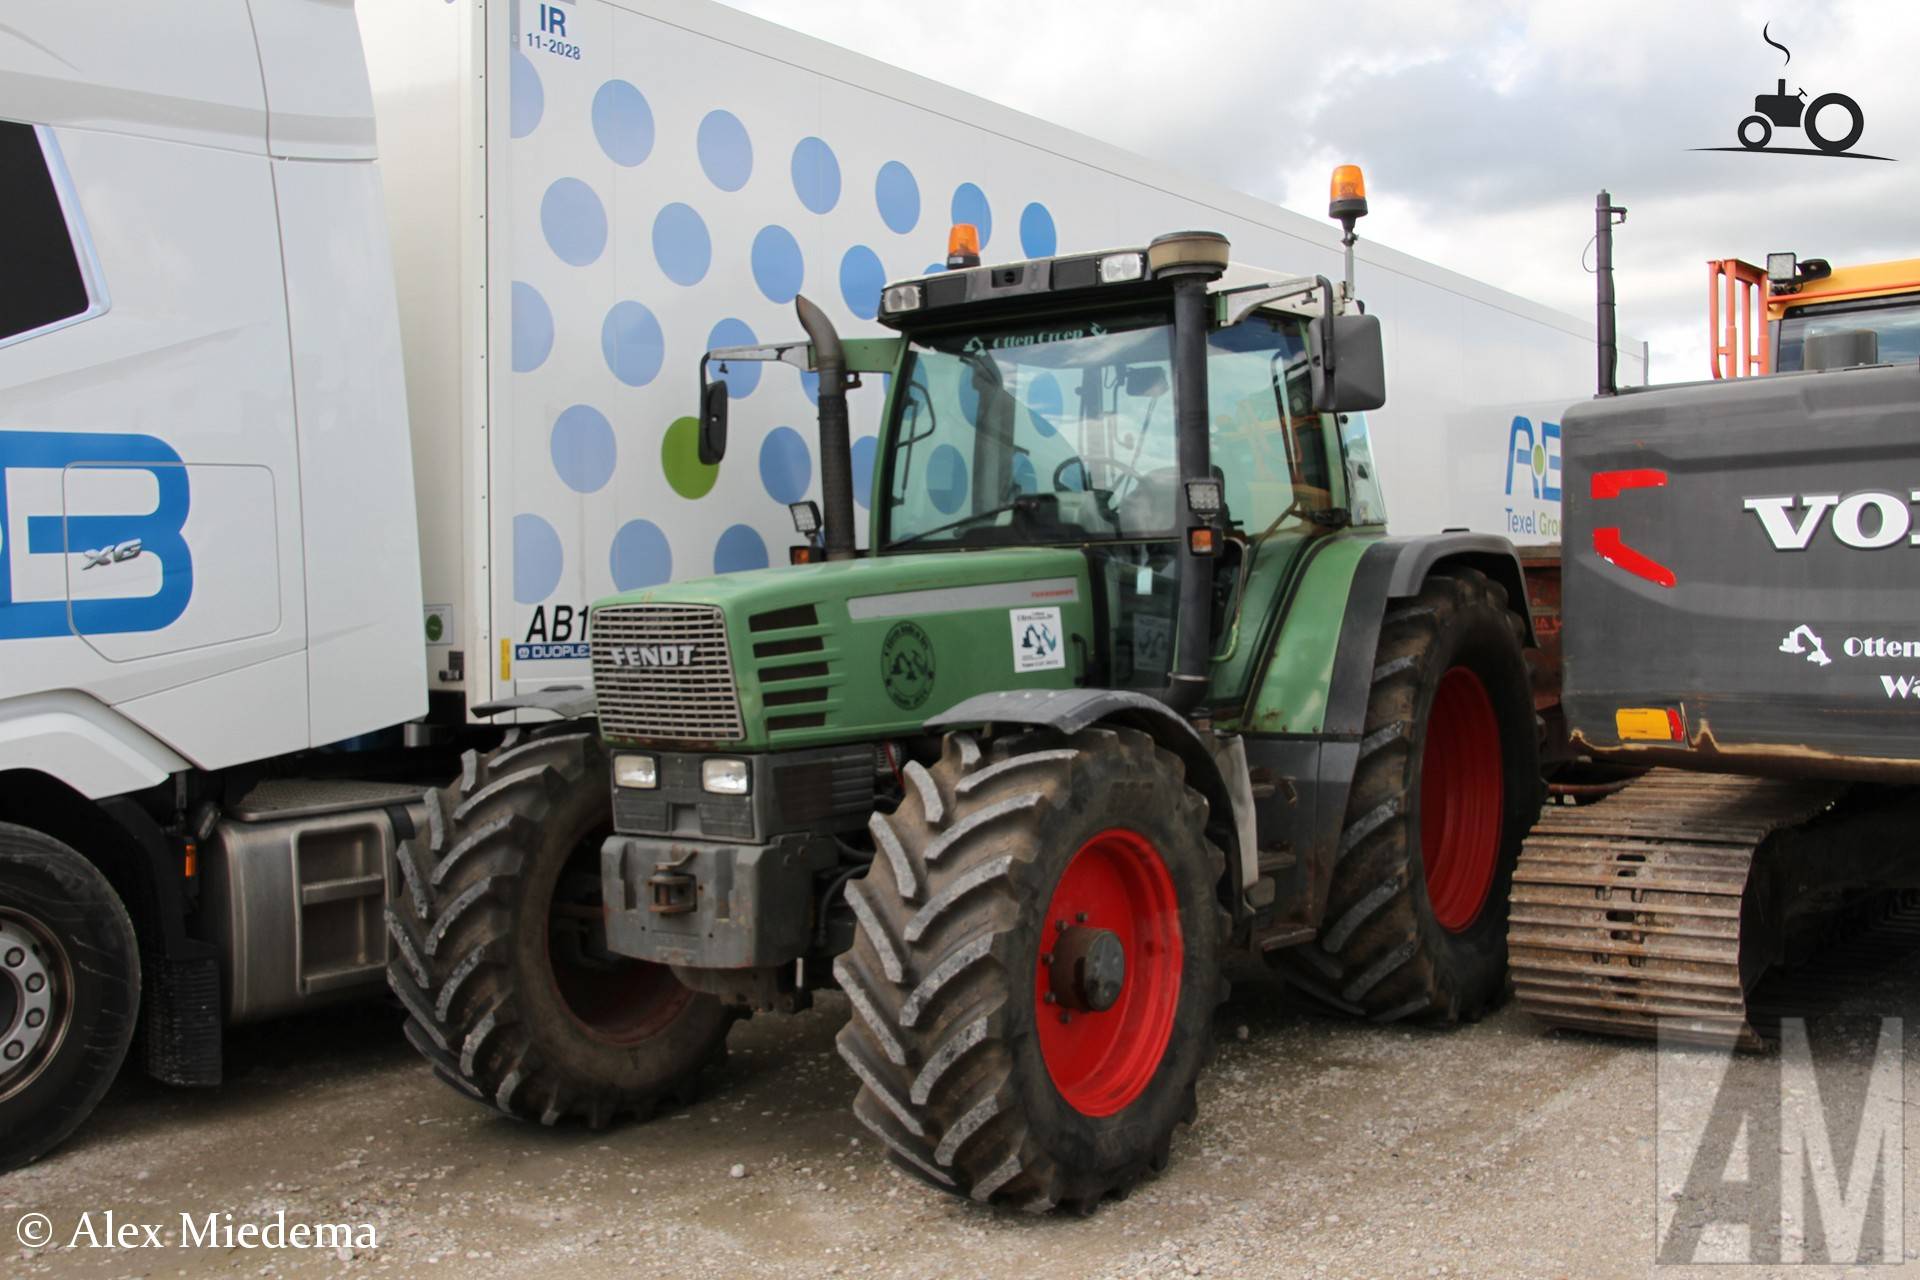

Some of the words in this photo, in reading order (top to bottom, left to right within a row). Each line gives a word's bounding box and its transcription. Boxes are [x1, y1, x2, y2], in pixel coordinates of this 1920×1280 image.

[540, 4, 567, 38] IR
[527, 33, 581, 60] 11-2028
[1505, 508, 1537, 535] Texel
[1744, 491, 1920, 549] VO
[525, 605, 589, 642] AB1
[532, 645, 591, 658] DUOPLE
[610, 645, 695, 667] FENDT
[1843, 636, 1920, 658] Otten
